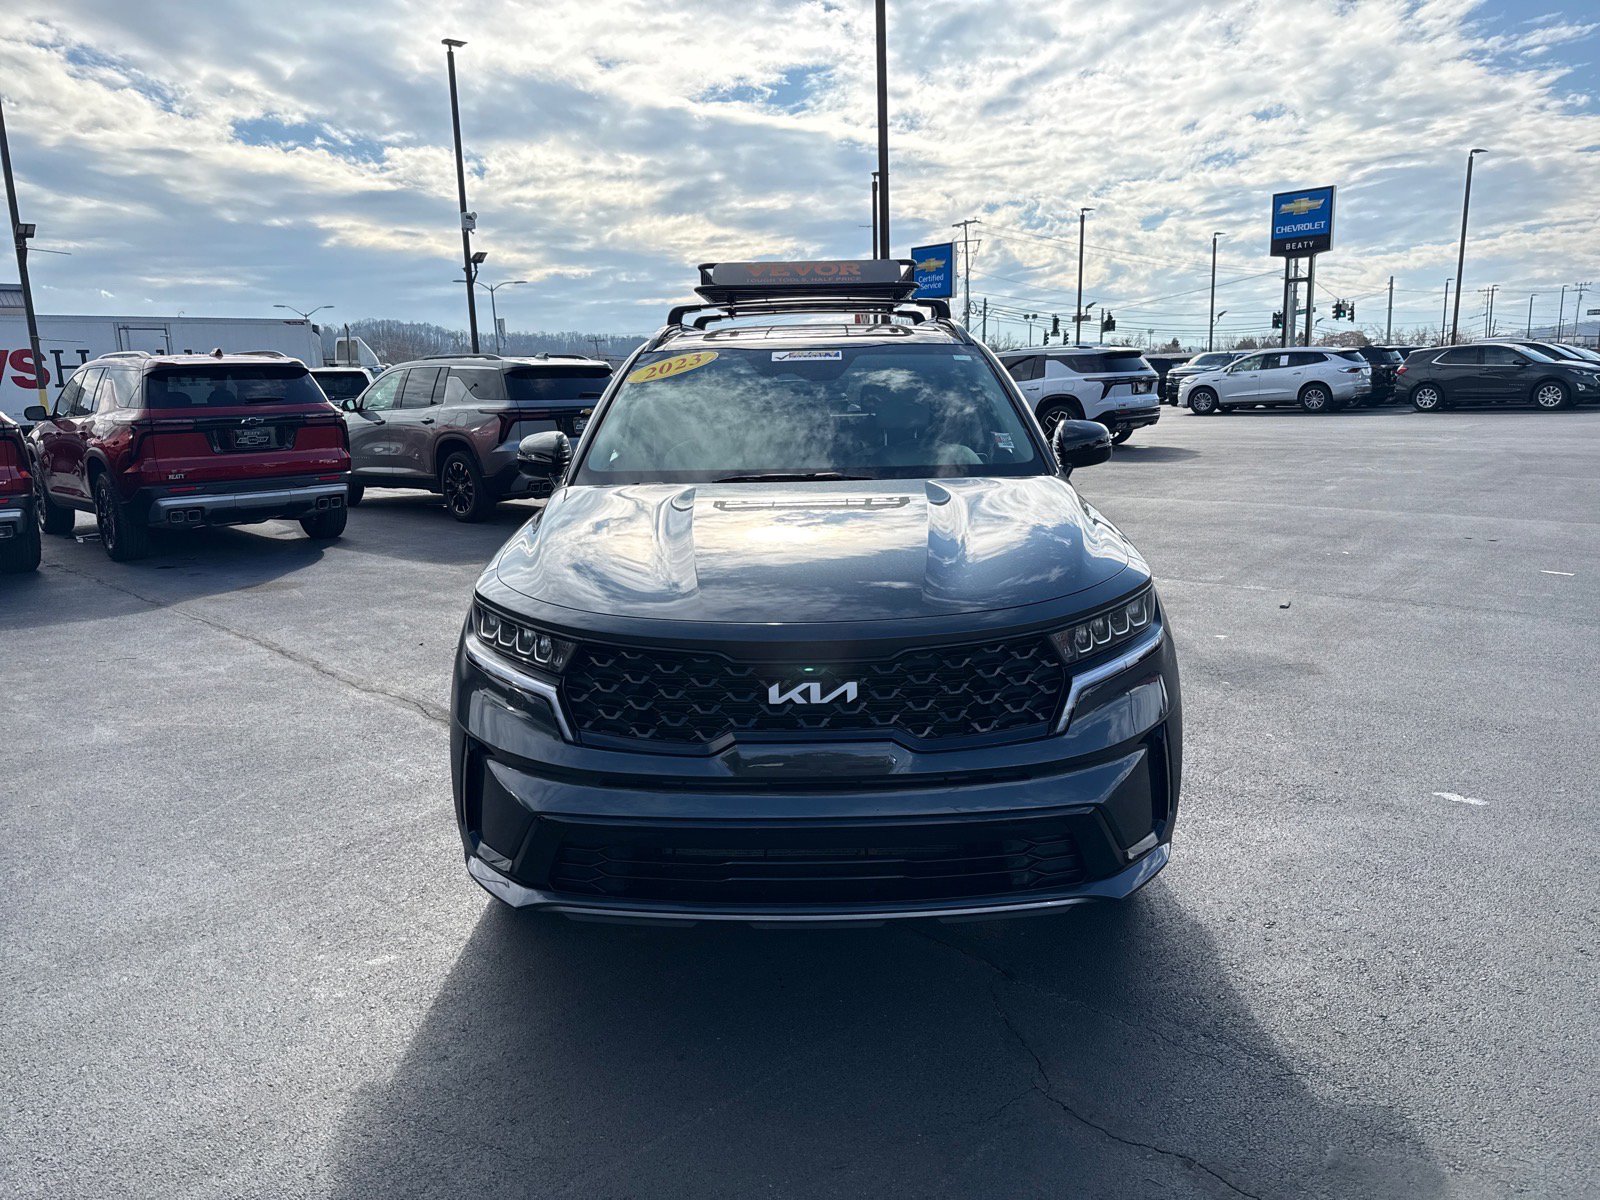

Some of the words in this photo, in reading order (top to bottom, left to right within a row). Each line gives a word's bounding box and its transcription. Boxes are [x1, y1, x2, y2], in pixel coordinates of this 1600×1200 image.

[1276, 221, 1326, 234] CHEVROLET
[1285, 241, 1314, 250] BEATY
[745, 262, 861, 276] VEVOR
[918, 273, 944, 282] Certified
[920, 282, 942, 290] Service
[645, 353, 702, 379] 2023
[768, 681, 858, 704] KIA
